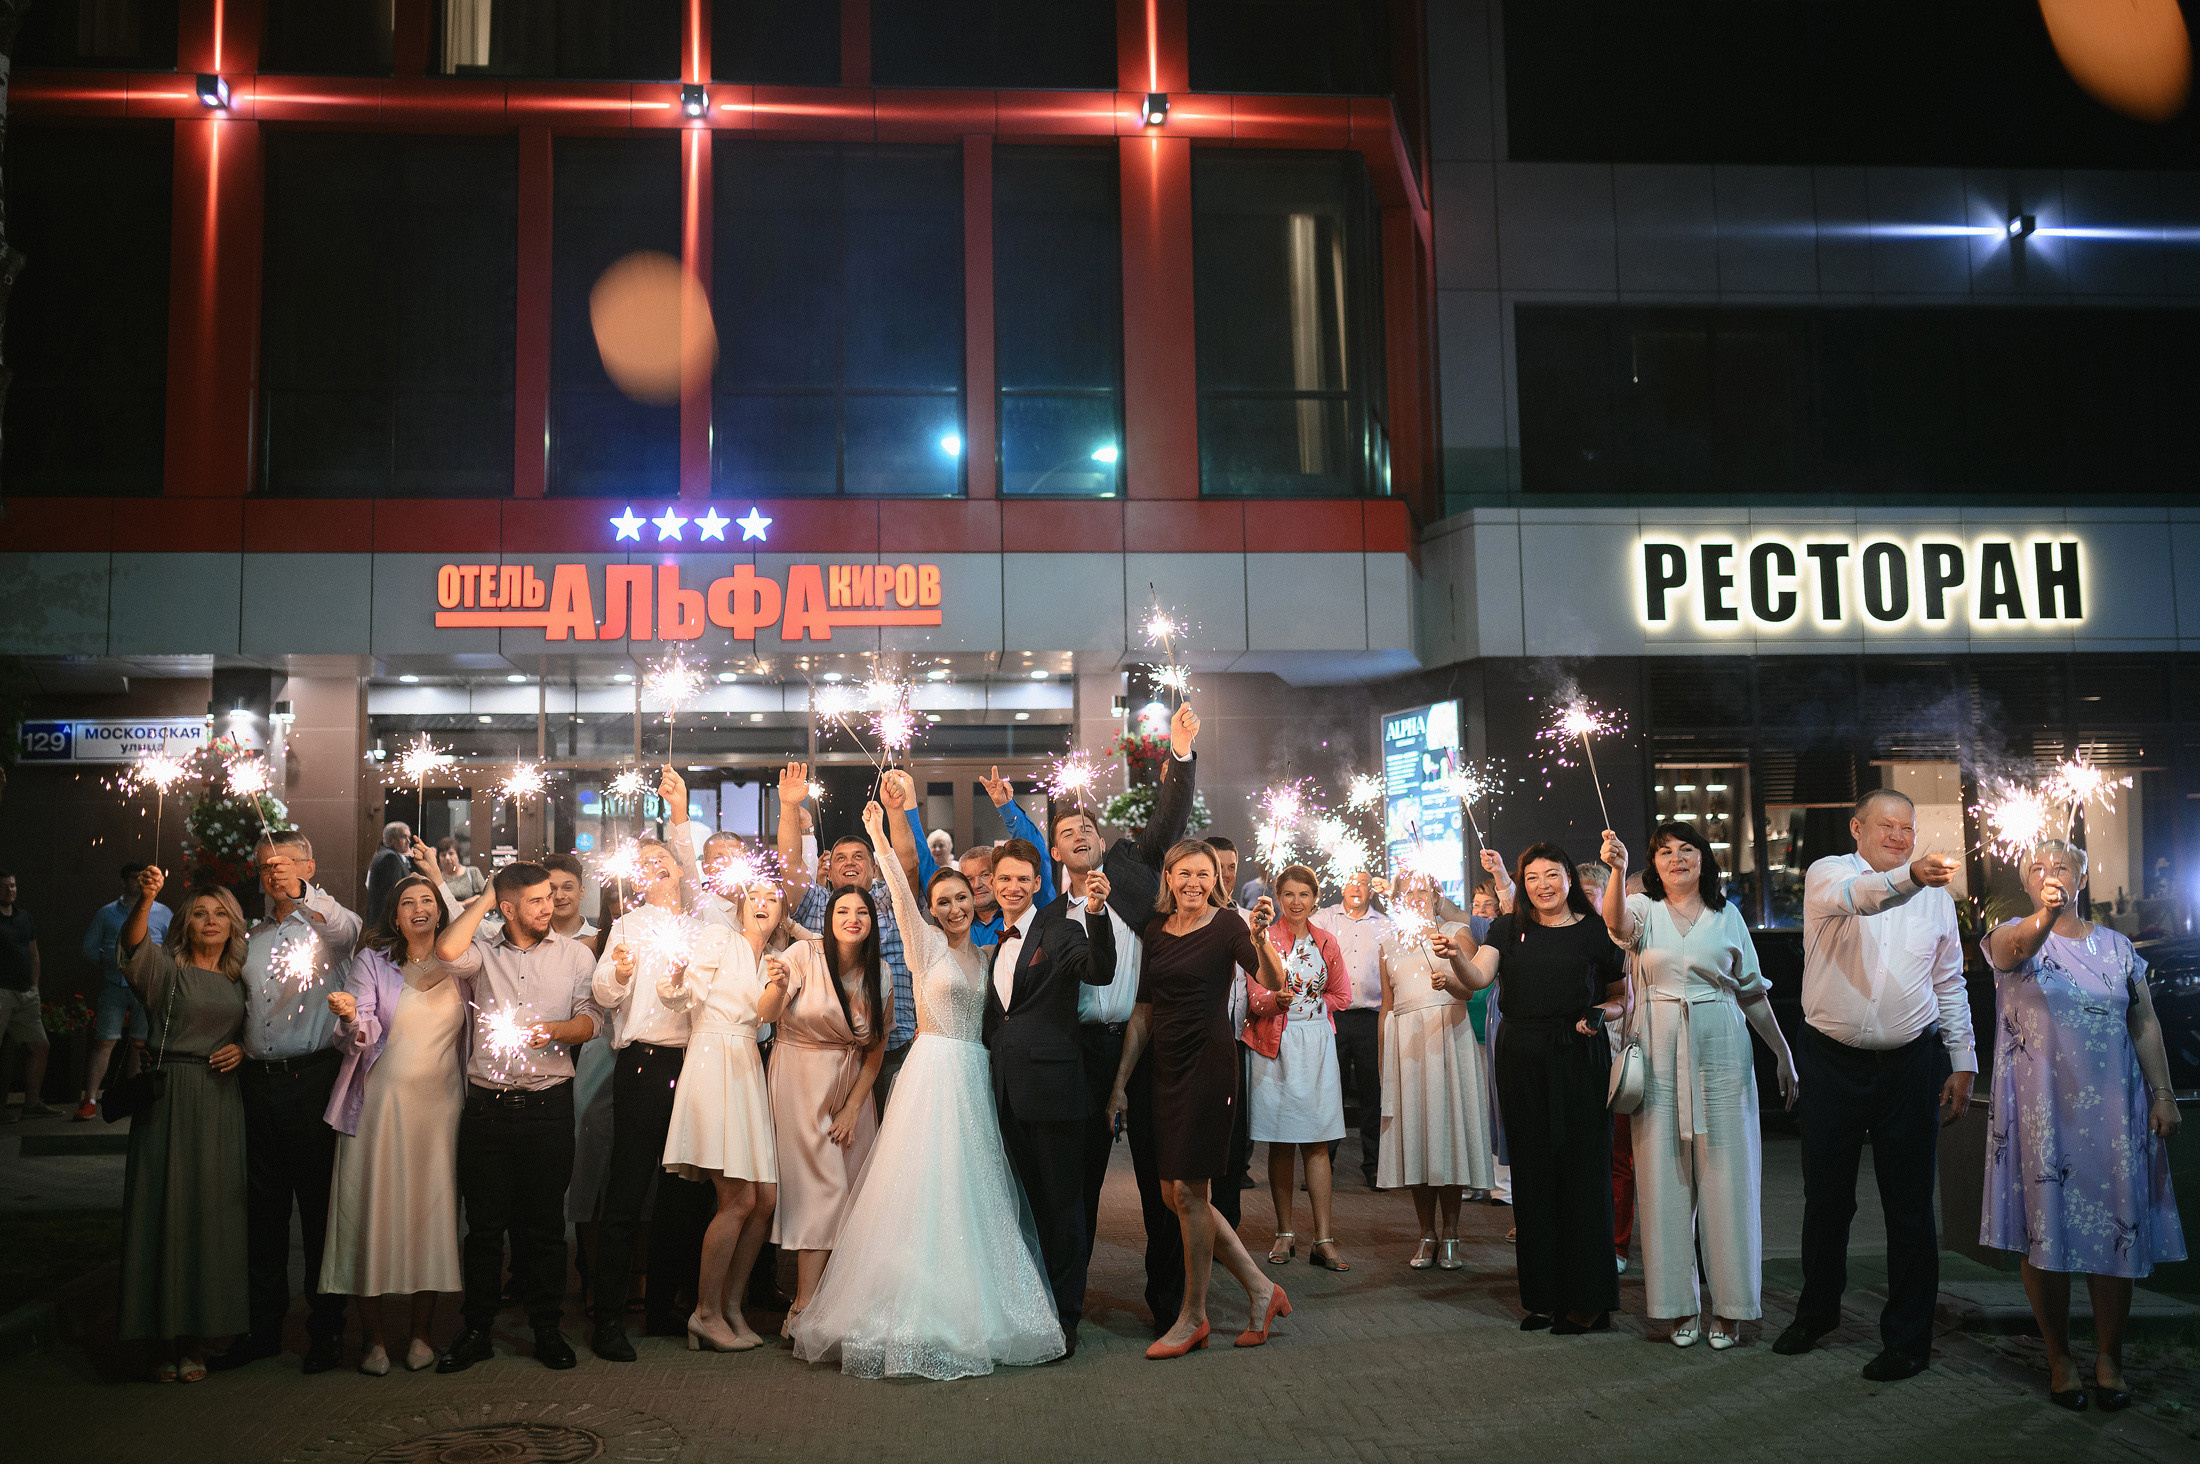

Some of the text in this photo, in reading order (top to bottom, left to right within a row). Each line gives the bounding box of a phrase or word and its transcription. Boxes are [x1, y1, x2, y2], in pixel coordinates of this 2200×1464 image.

[437, 563, 942, 640] ОТЕЛЬ АЛЬФА КИРОВ
[1644, 541, 2084, 622] РЕСТОРАН
[85, 727, 201, 740] МОСКОВСКАЯ
[1385, 715, 1427, 741] ALPHA
